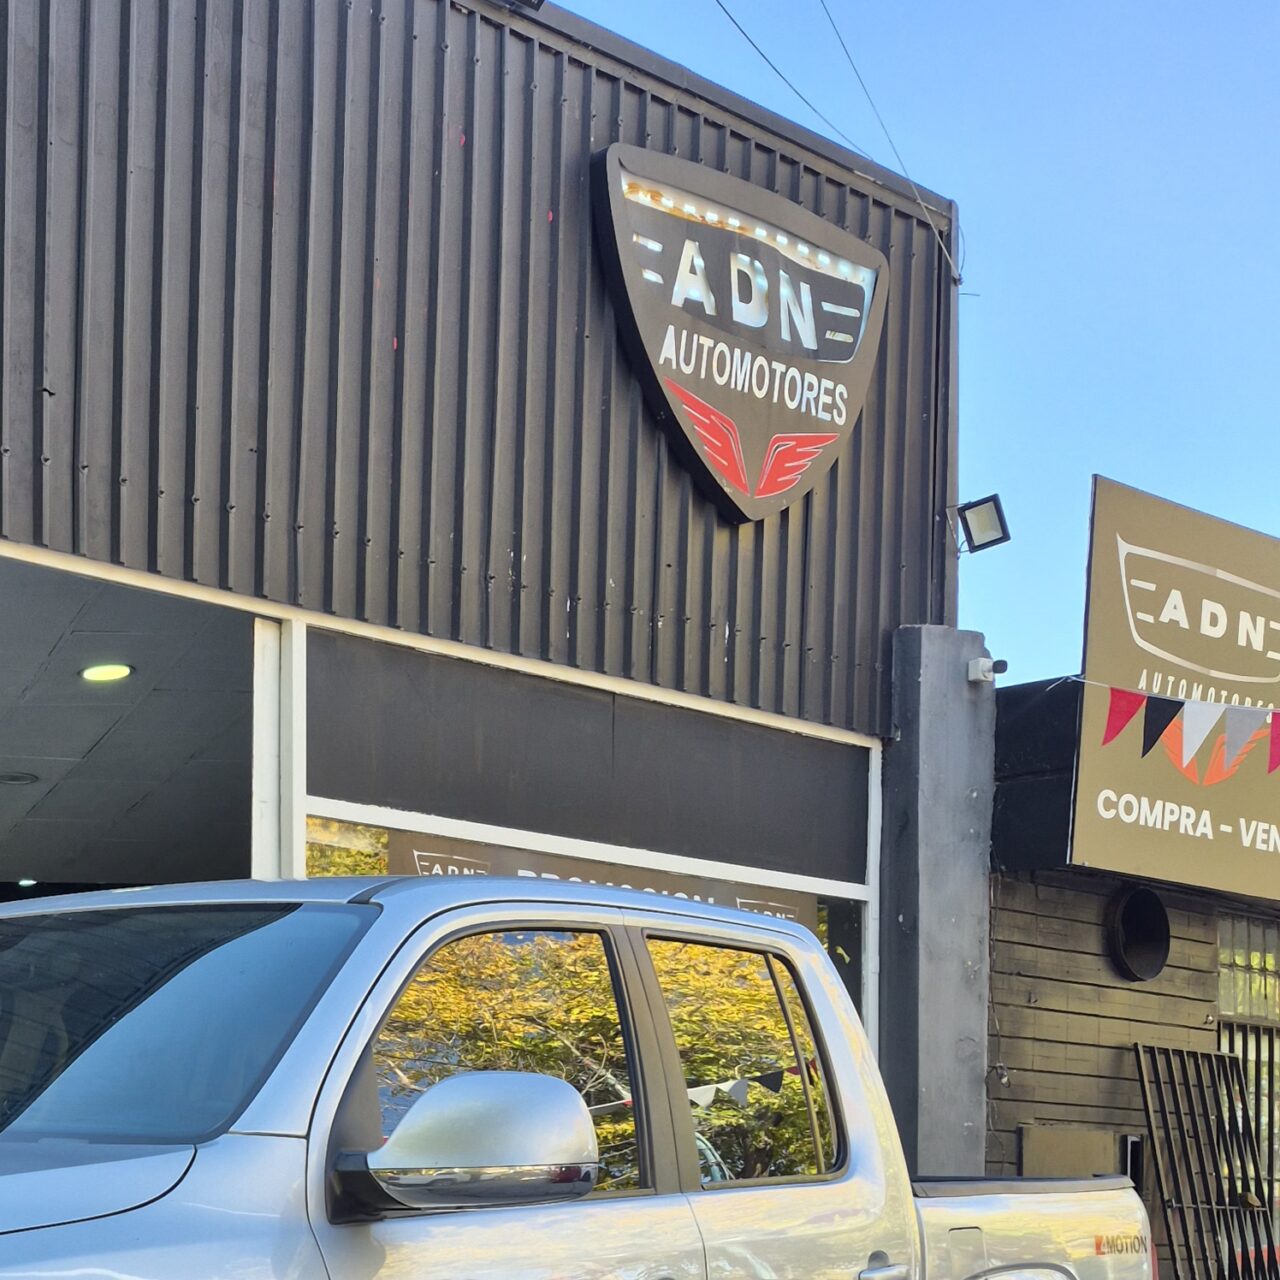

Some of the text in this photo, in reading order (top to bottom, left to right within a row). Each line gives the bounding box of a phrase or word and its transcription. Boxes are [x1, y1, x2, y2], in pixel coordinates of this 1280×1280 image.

[671, 239, 818, 350] ADN
[659, 325, 848, 426] AUTOMOTORES
[1159, 589, 1265, 652] ADN
[1097, 789, 1214, 840] COMPRA
[1239, 817, 1280, 854] VEN
